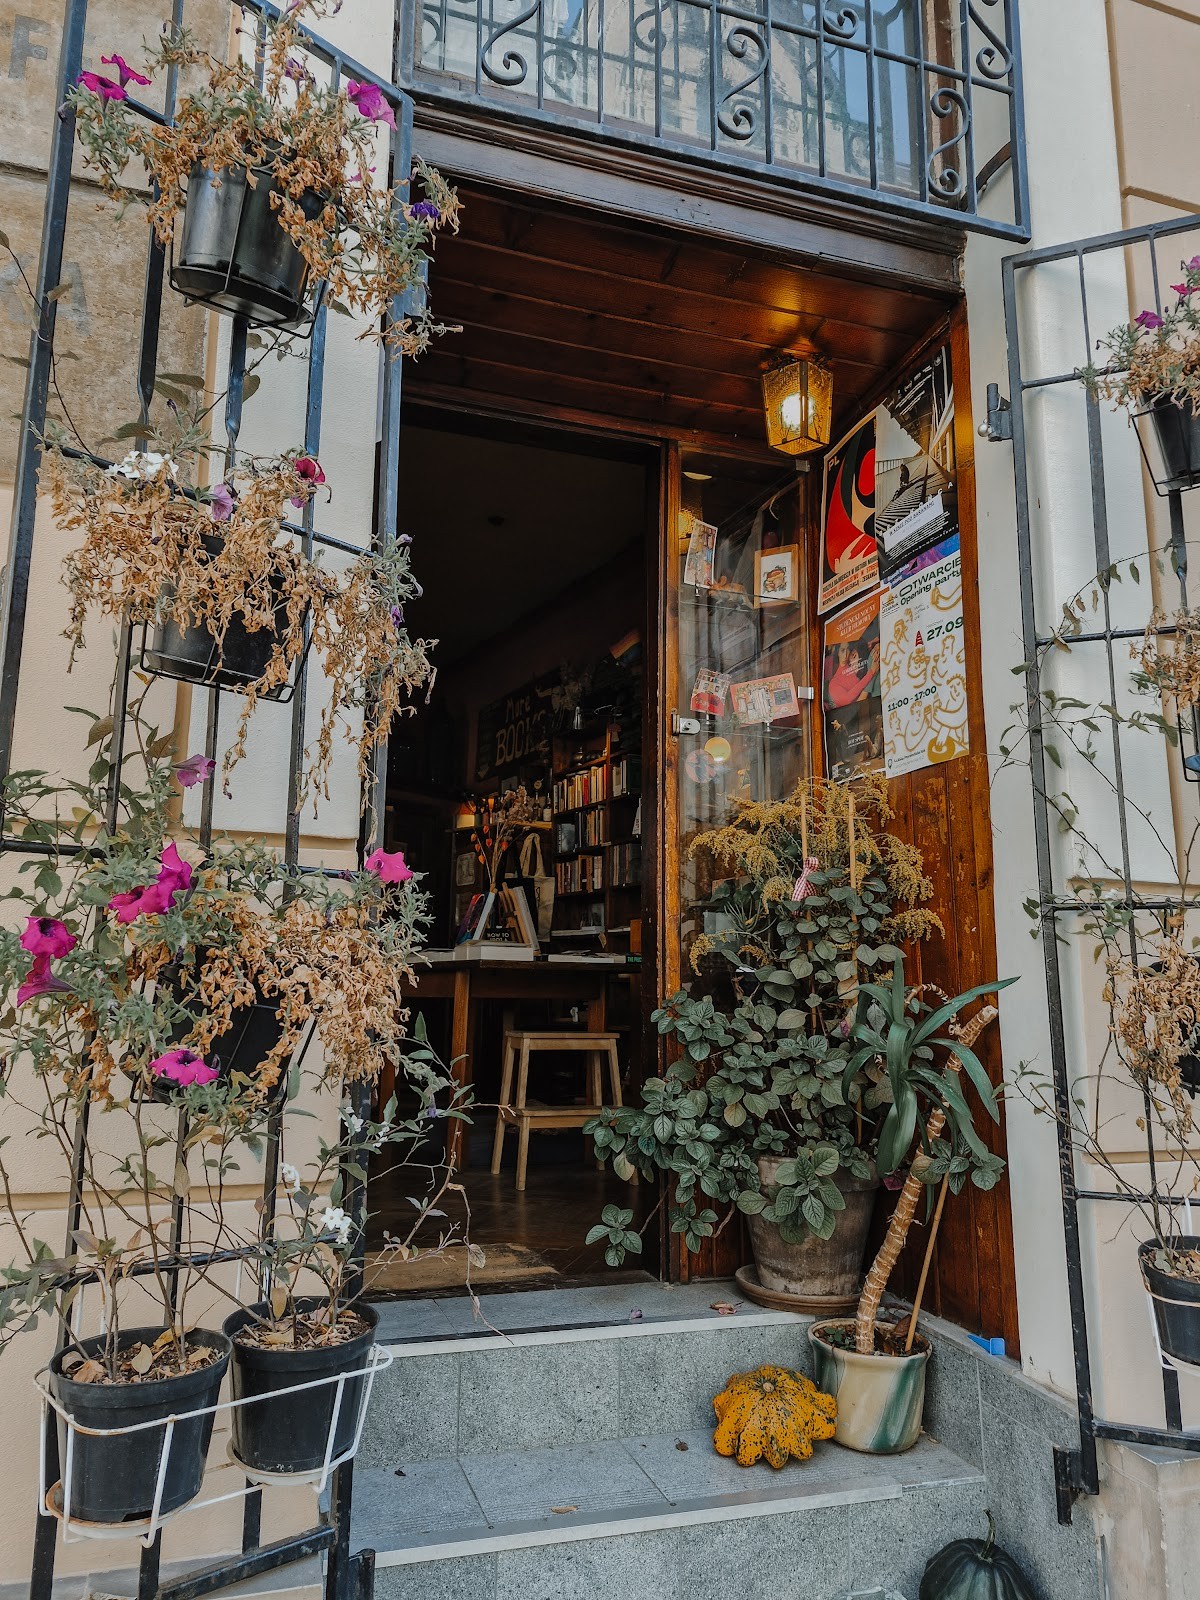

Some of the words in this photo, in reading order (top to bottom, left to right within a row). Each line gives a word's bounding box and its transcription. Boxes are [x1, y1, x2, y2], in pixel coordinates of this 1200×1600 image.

[828, 456, 840, 472] PL
[899, 557, 961, 597] OTWARCIE
[900, 583, 932, 606] Opening
[935, 569, 961, 587] party
[926, 616, 963, 641] 27.09
[505, 694, 531, 724] More
[887, 697, 909, 712] 11:00
[914, 685, 937, 702] 17:00
